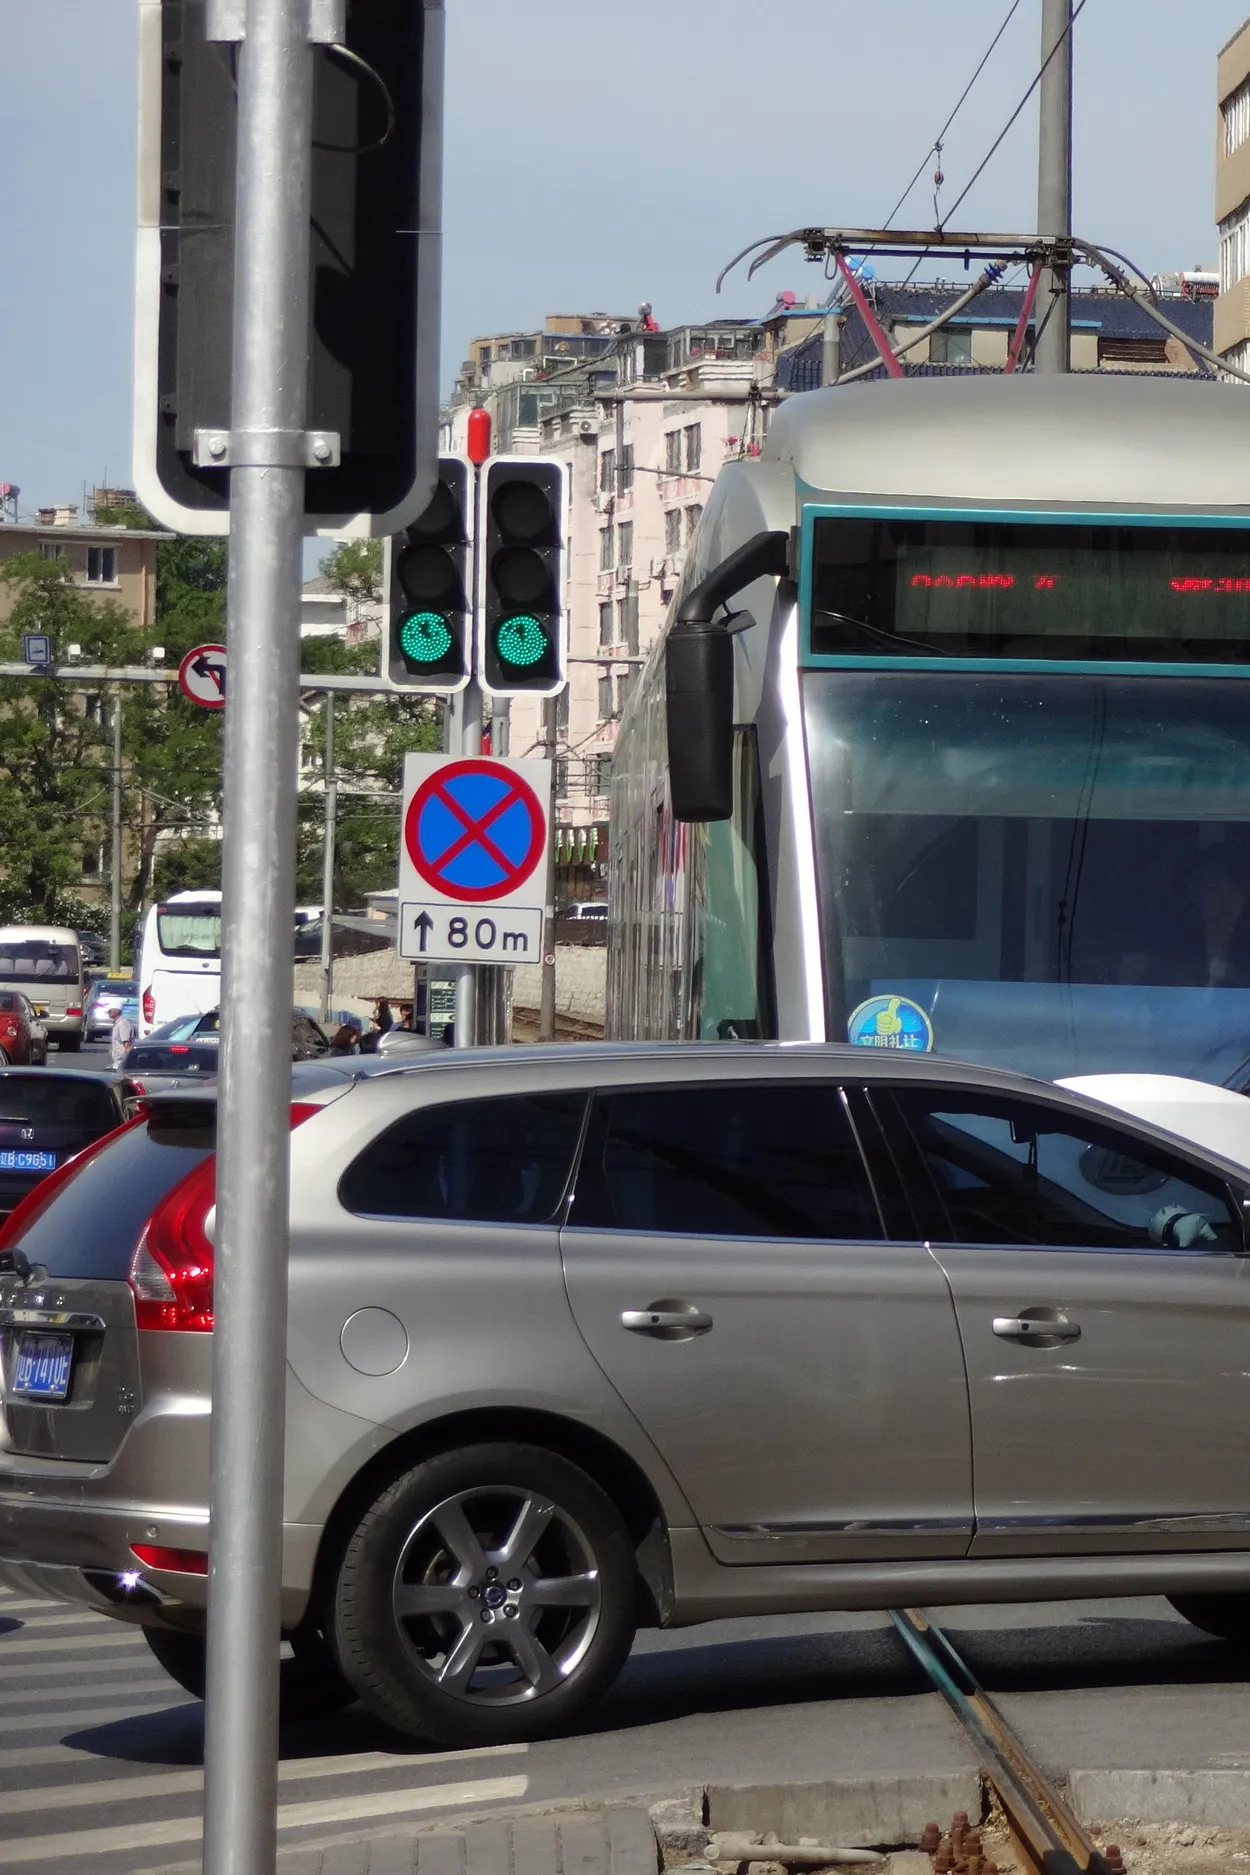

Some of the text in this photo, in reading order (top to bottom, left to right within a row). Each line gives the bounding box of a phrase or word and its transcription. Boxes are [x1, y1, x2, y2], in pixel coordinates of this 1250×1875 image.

[447, 916, 529, 951] 80m
[859, 1034, 918, 1048] 文明礼让
